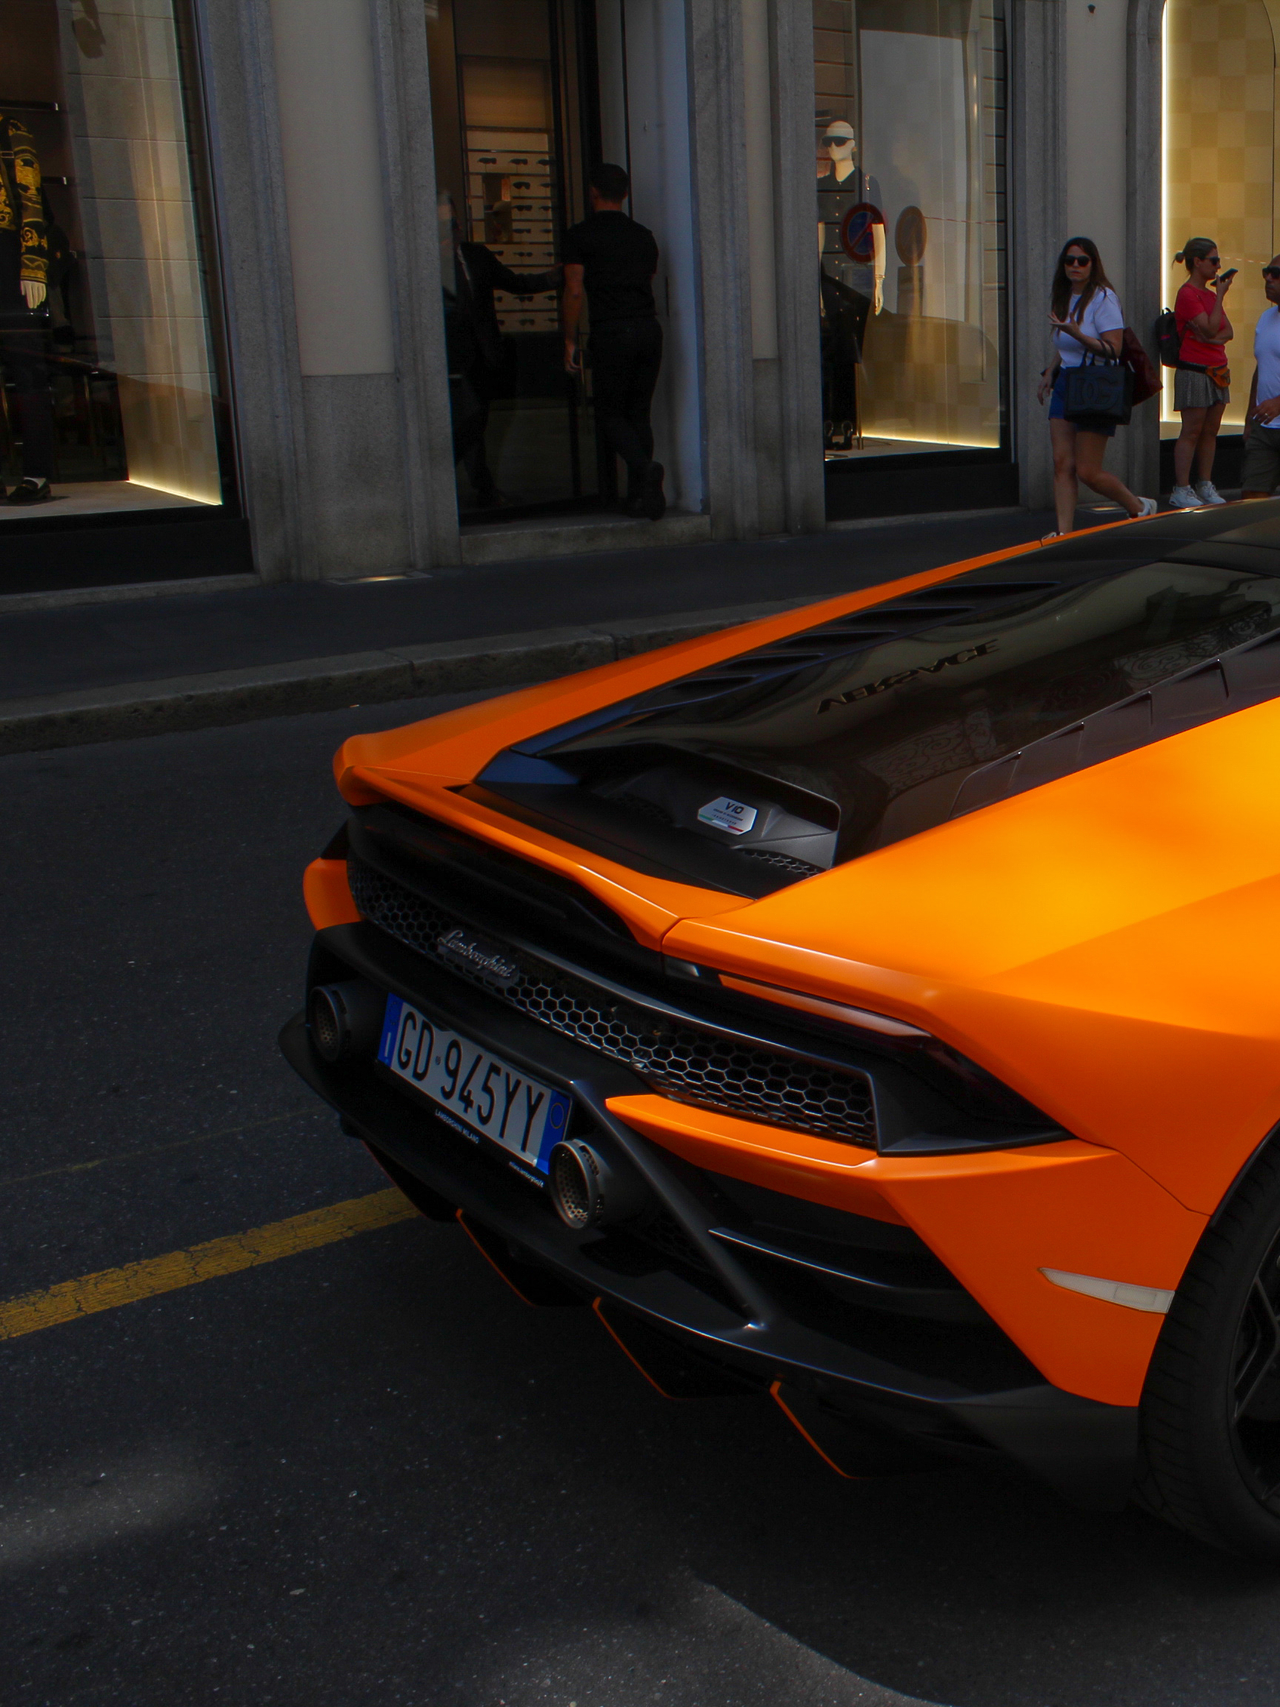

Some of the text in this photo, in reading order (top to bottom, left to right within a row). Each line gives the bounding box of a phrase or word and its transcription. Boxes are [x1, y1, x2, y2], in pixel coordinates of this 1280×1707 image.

[725, 801, 745, 816] V10
[437, 929, 517, 978] Lamborghini
[397, 1011, 434, 1082] GD
[440, 1039, 545, 1154] 945YY
